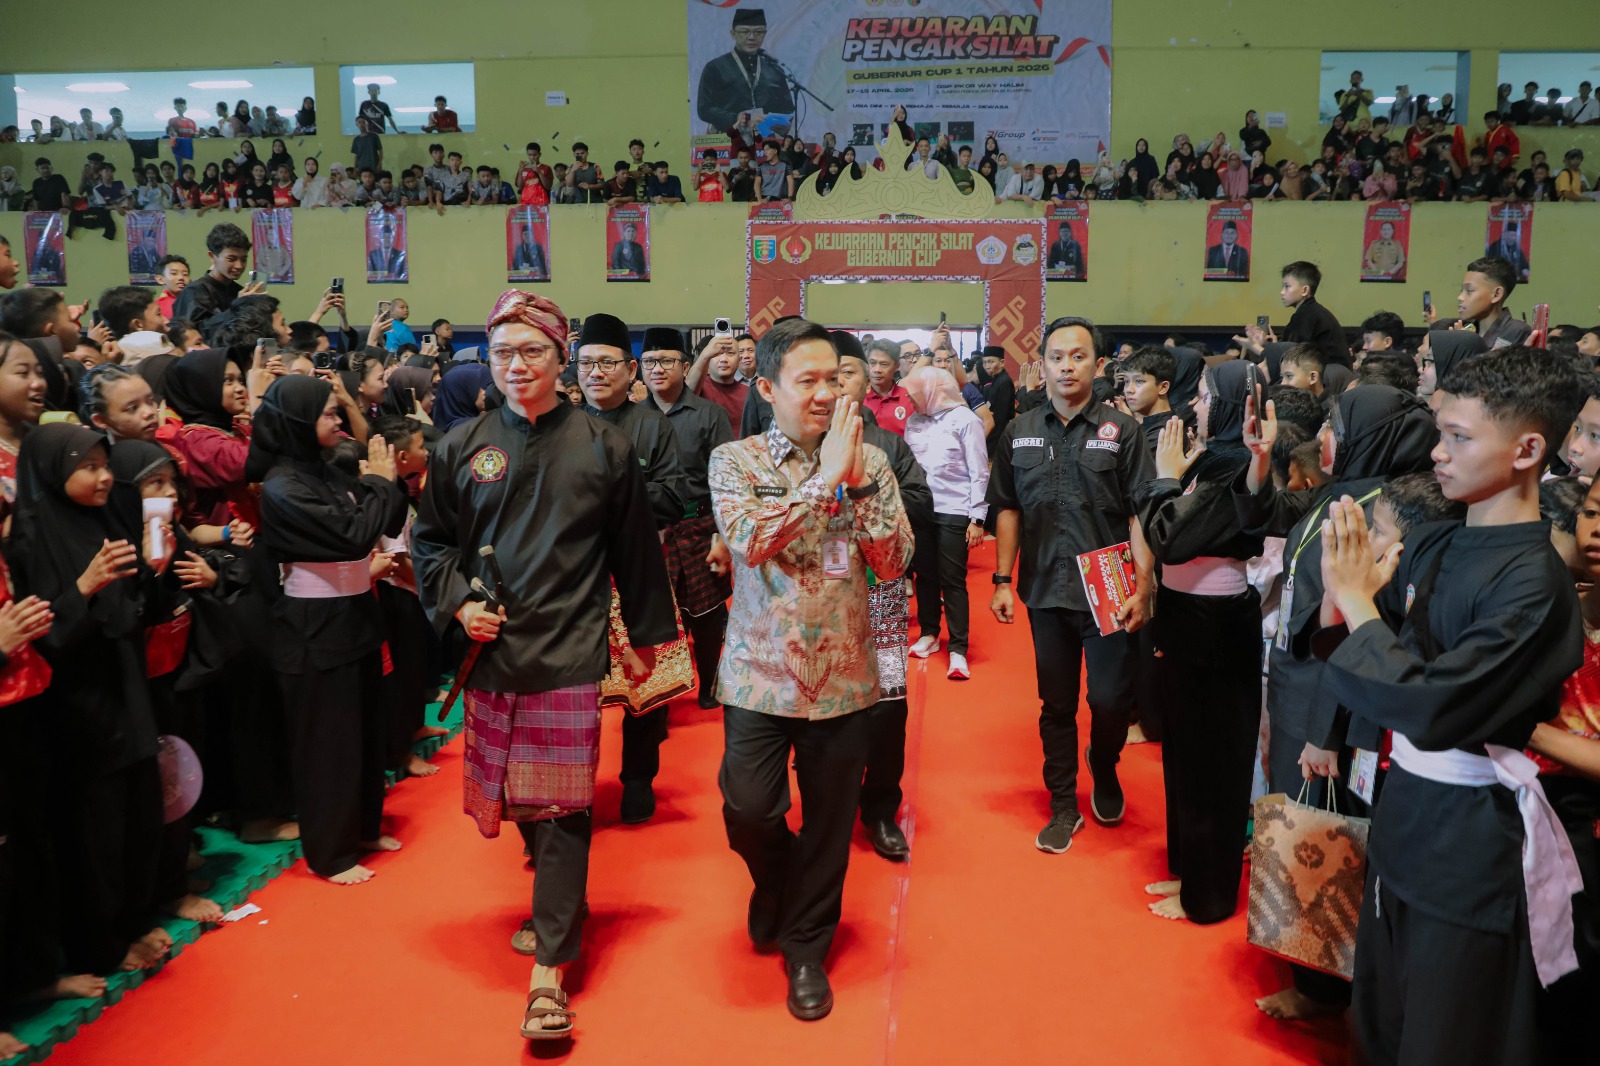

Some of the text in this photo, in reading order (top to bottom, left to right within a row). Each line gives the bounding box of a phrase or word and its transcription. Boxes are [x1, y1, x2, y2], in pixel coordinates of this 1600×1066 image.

[846, 15, 1036, 39] KEJUARAAN
[843, 34, 1058, 60] PENCAK SILAT
[853, 69, 922, 81] GUBERNUR
[925, 68, 953, 77] CUP
[966, 64, 1016, 74] TAHUN
[1016, 63, 1050, 73] 2026
[815, 232, 975, 250] KEJUARAAN PENCAK SILAT
[847, 250, 941, 267] GUBERNUR CUP
